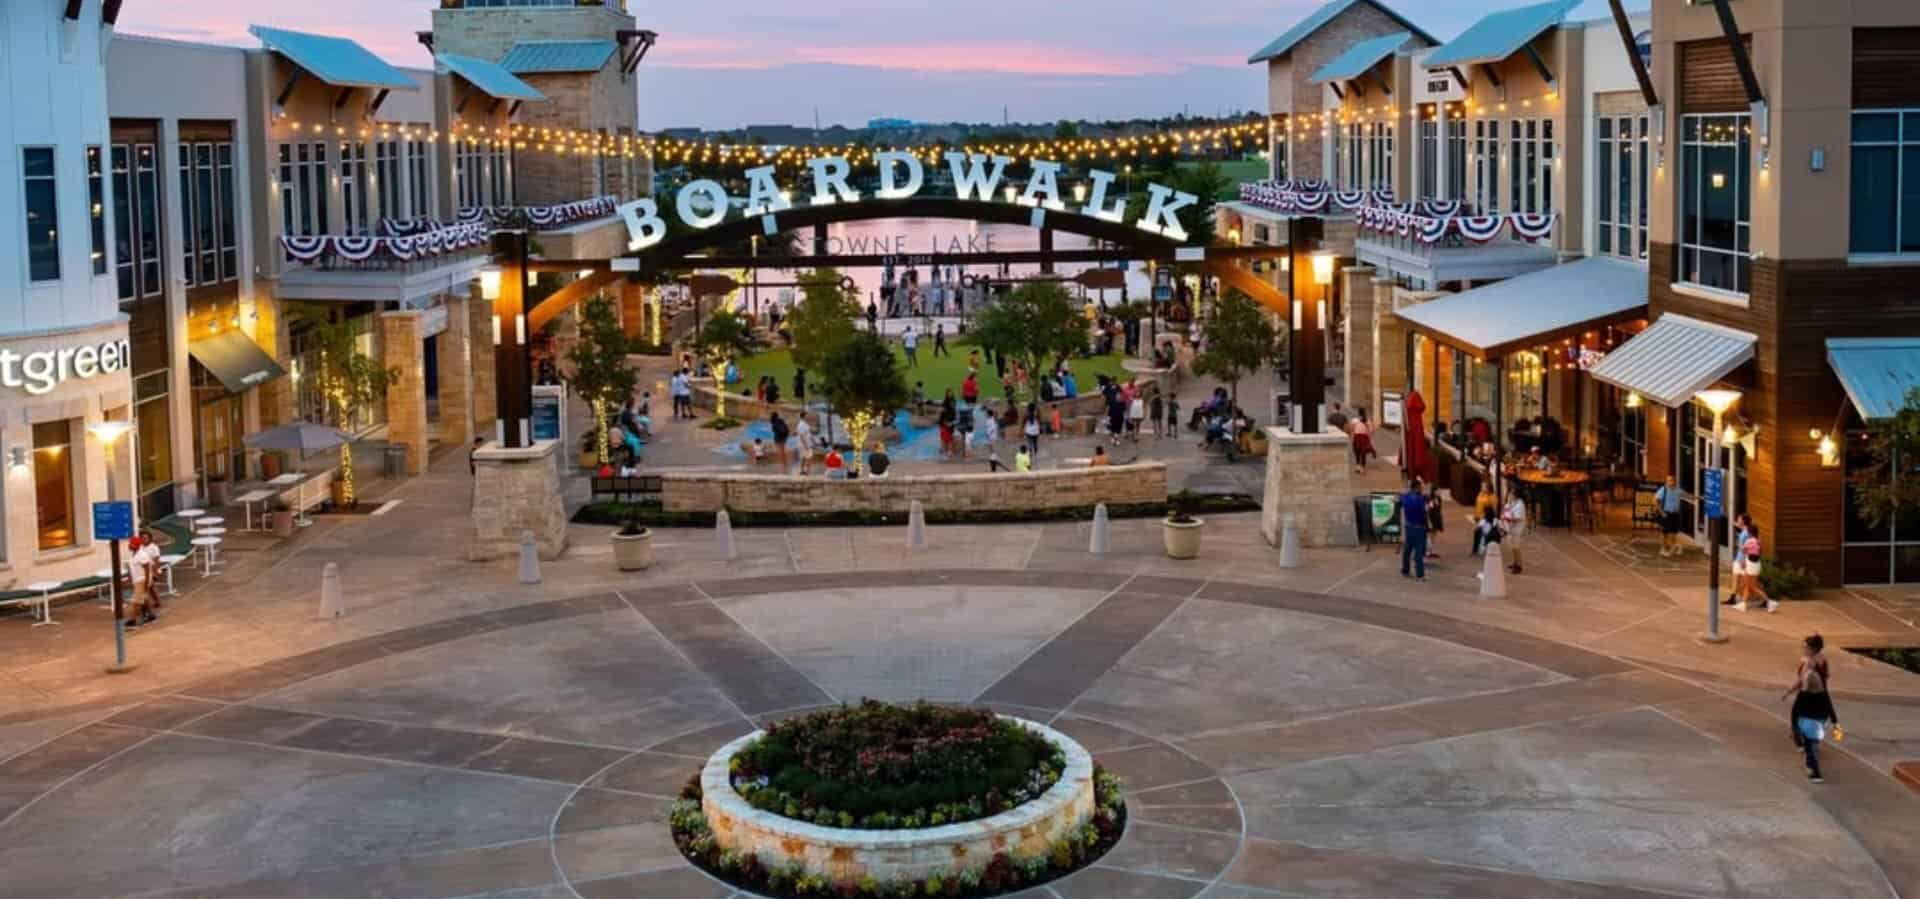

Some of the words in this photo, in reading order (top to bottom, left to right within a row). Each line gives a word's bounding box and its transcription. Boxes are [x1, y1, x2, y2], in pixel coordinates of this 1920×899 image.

[616, 151, 1199, 250] BOARDWALK
[932, 232, 997, 252] LAKE
[0, 339, 130, 395] tgreen
